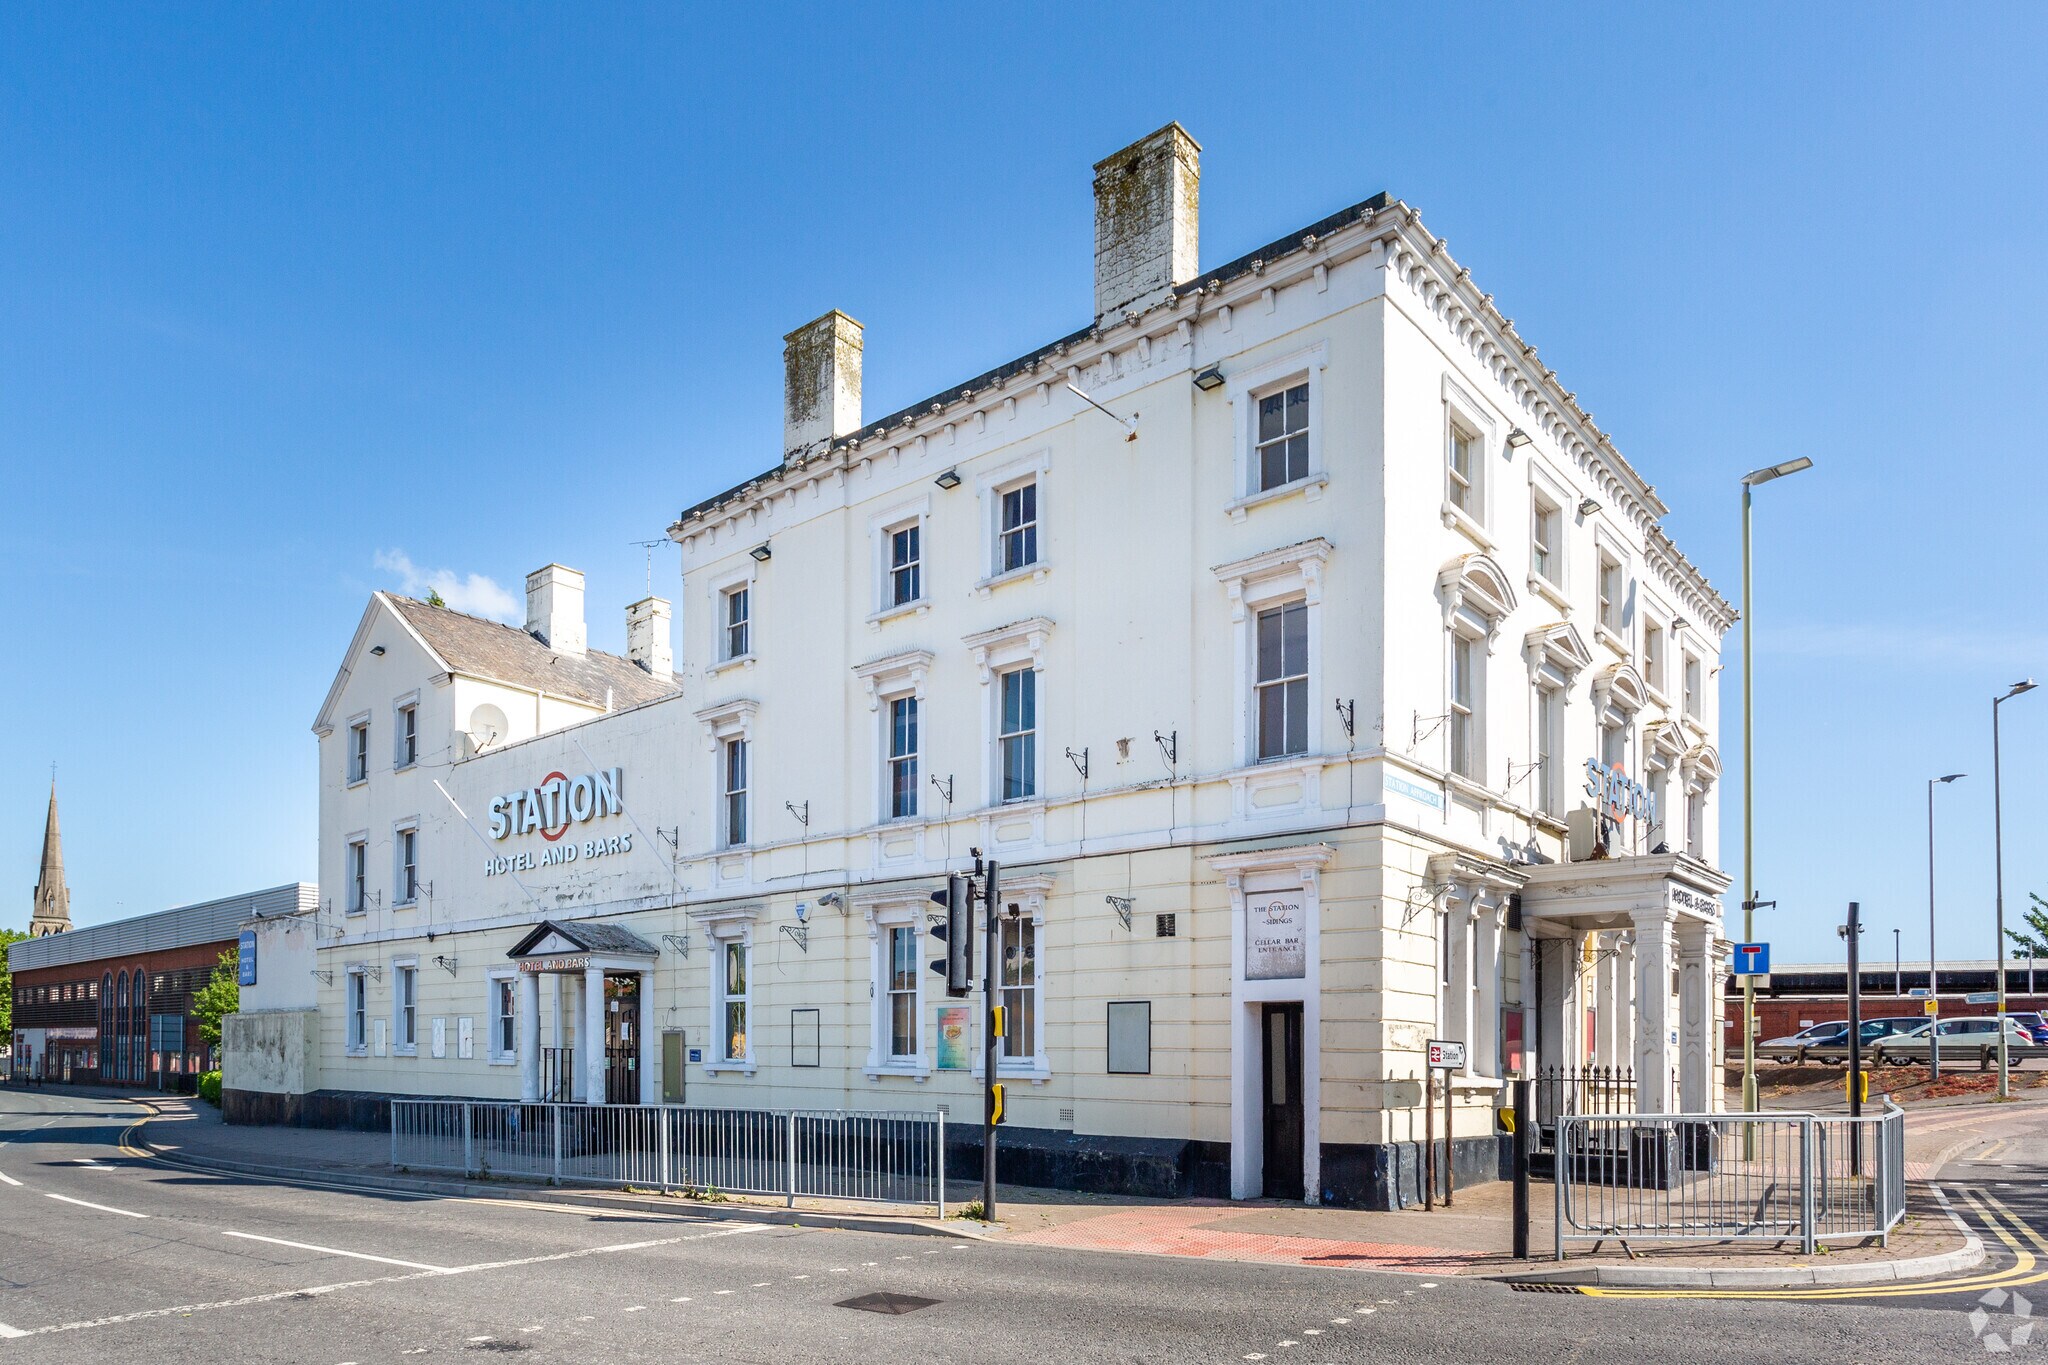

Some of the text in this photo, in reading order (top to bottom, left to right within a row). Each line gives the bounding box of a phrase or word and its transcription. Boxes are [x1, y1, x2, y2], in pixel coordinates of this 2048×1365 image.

[1384, 776, 1437, 805] STATION APPROACH
[1583, 757, 1657, 826] STATION
[488, 767, 623, 840] STATION
[485, 833, 632, 877] HOTEL AND BARS
[1672, 888, 1694, 908] HOTEL
[1268, 904, 1300, 912] STATION
[1266, 917, 1293, 926] SIDINGS
[240, 941, 254, 949] STATION
[1284, 937, 1299, 945] BAR
[518, 957, 591, 972] HOTEL AND BARS
[1442, 1050, 1459, 1061] Station
